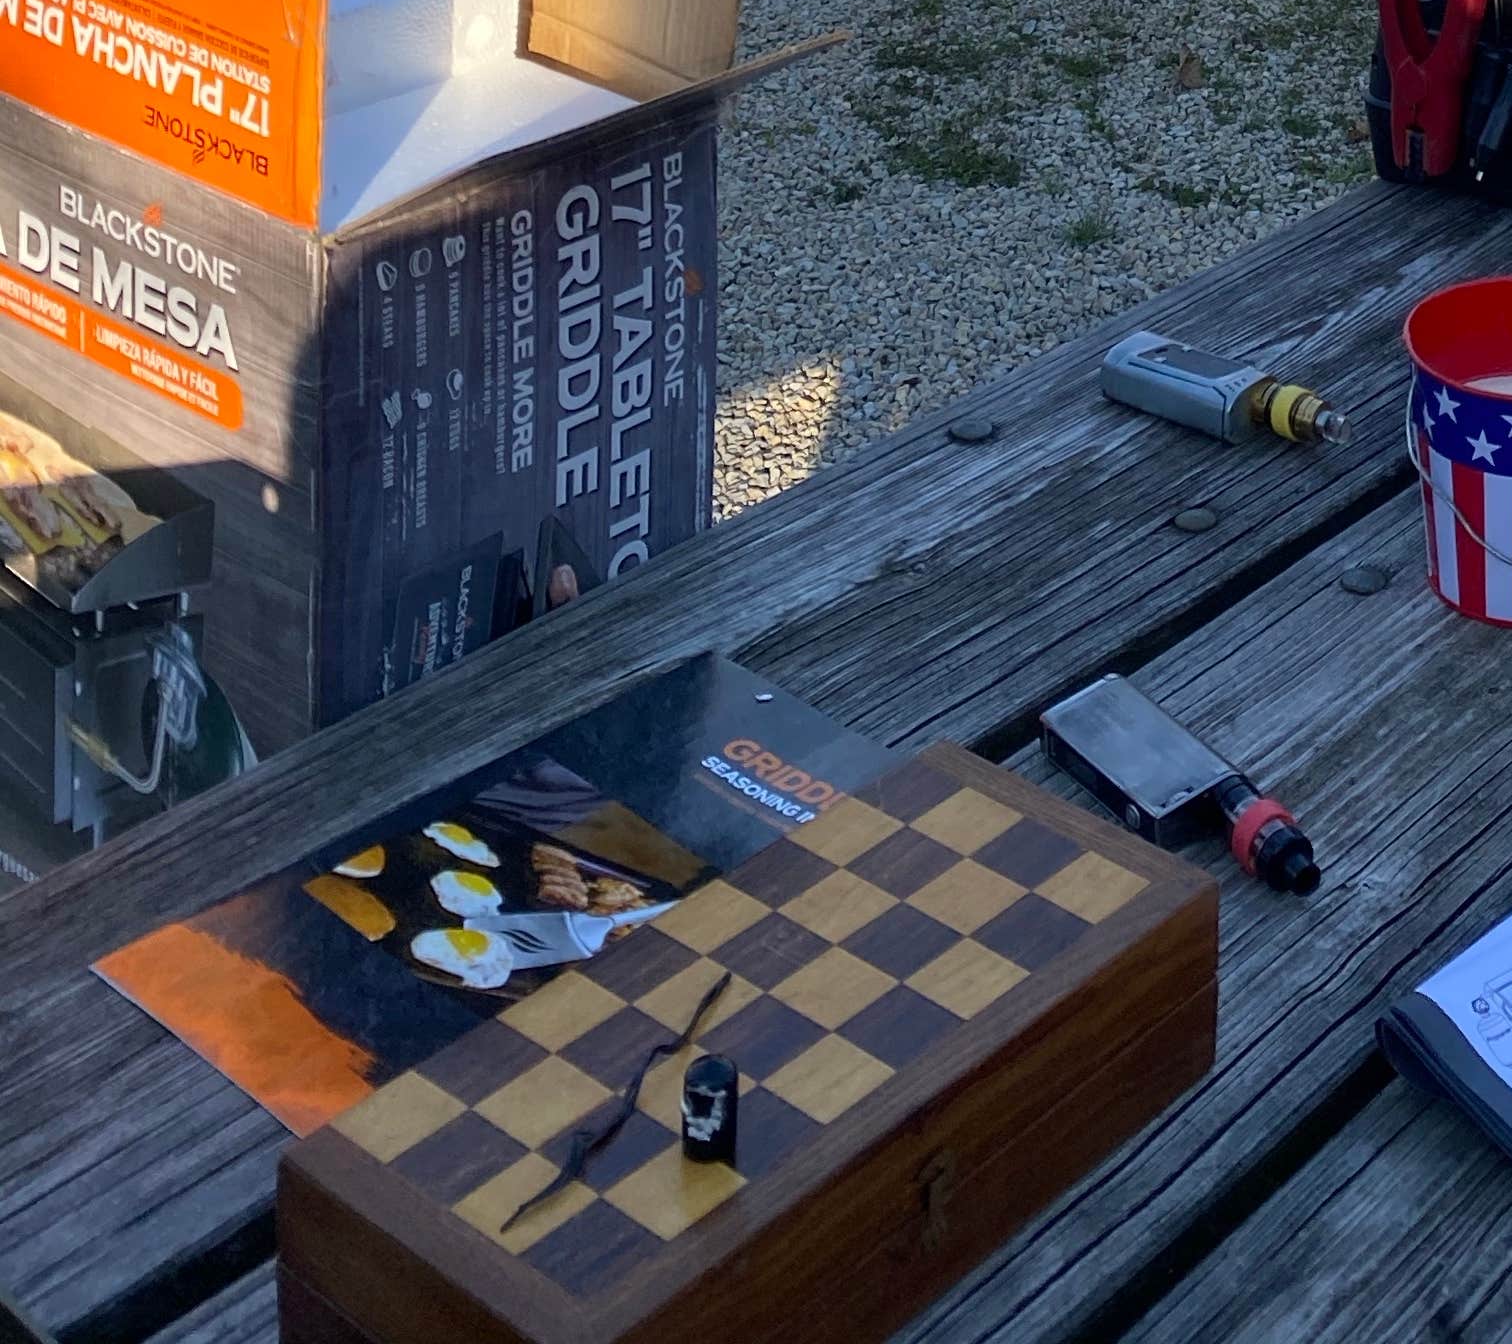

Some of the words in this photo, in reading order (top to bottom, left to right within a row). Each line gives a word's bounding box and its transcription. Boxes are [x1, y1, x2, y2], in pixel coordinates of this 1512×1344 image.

[88, 0, 125, 29] AVEC
[126, 16, 188, 58] CUISSON
[188, 45, 217, 69] DE
[70, 15, 224, 117] PLANCHA
[212, 62, 271, 95] STATION
[144, 104, 269, 177] BLACKSTONE
[229, 92, 270, 138] 17"
[59, 184, 238, 295] BLACKSTONE
[609, 162, 654, 252] 17"
[18, 209, 81, 294] DE
[92, 245, 239, 373] MESA
[511, 209, 535, 364] GRIDDLE
[662, 151, 685, 408] BLACKSTONE
[555, 184, 601, 508] GRIDDLE
[511, 366, 535, 473] MORE
[701, 755, 801, 818] SEASONING
